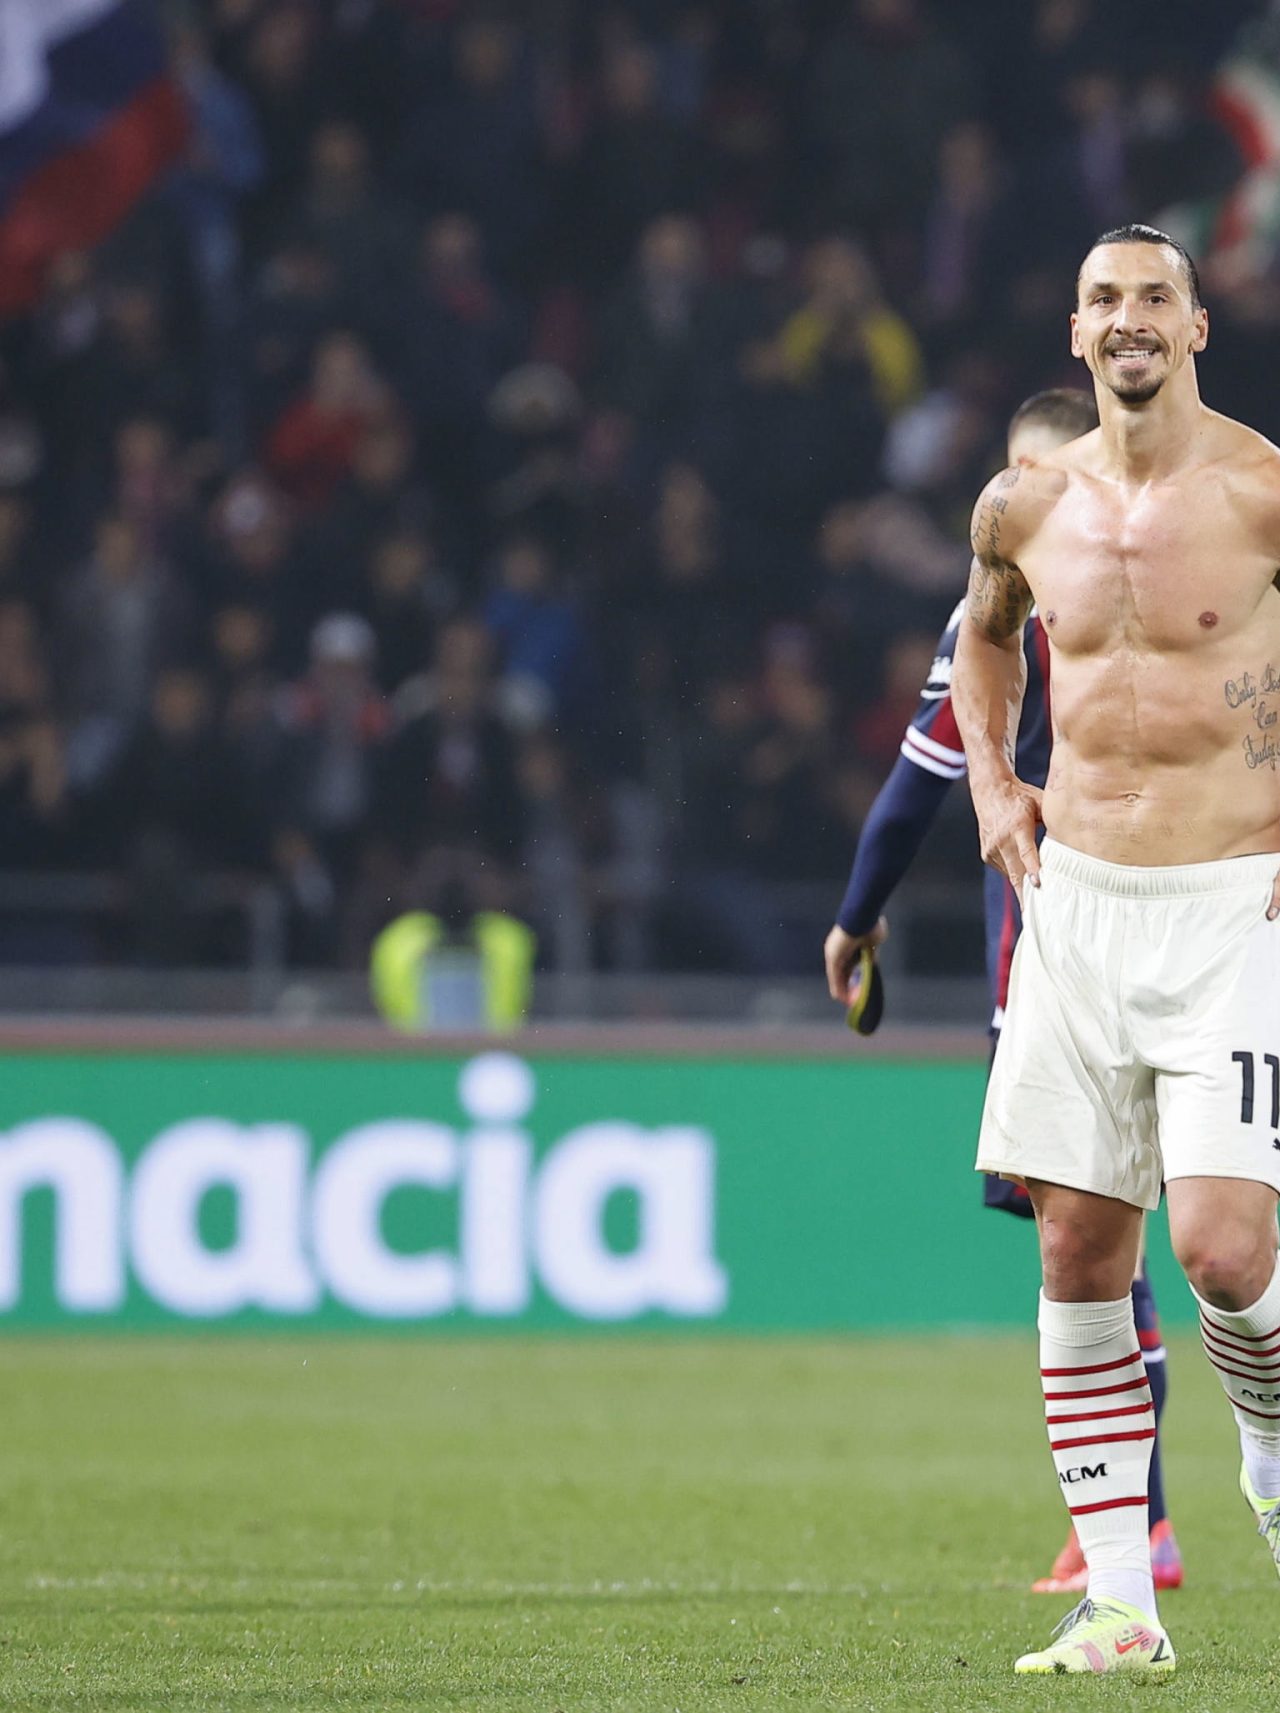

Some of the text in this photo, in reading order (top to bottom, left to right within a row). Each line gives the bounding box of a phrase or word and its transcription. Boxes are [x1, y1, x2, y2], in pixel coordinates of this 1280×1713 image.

[1225, 672, 1257, 708] Only
[1252, 701, 1278, 729] Can
[1232, 1051, 1280, 1129] 11
